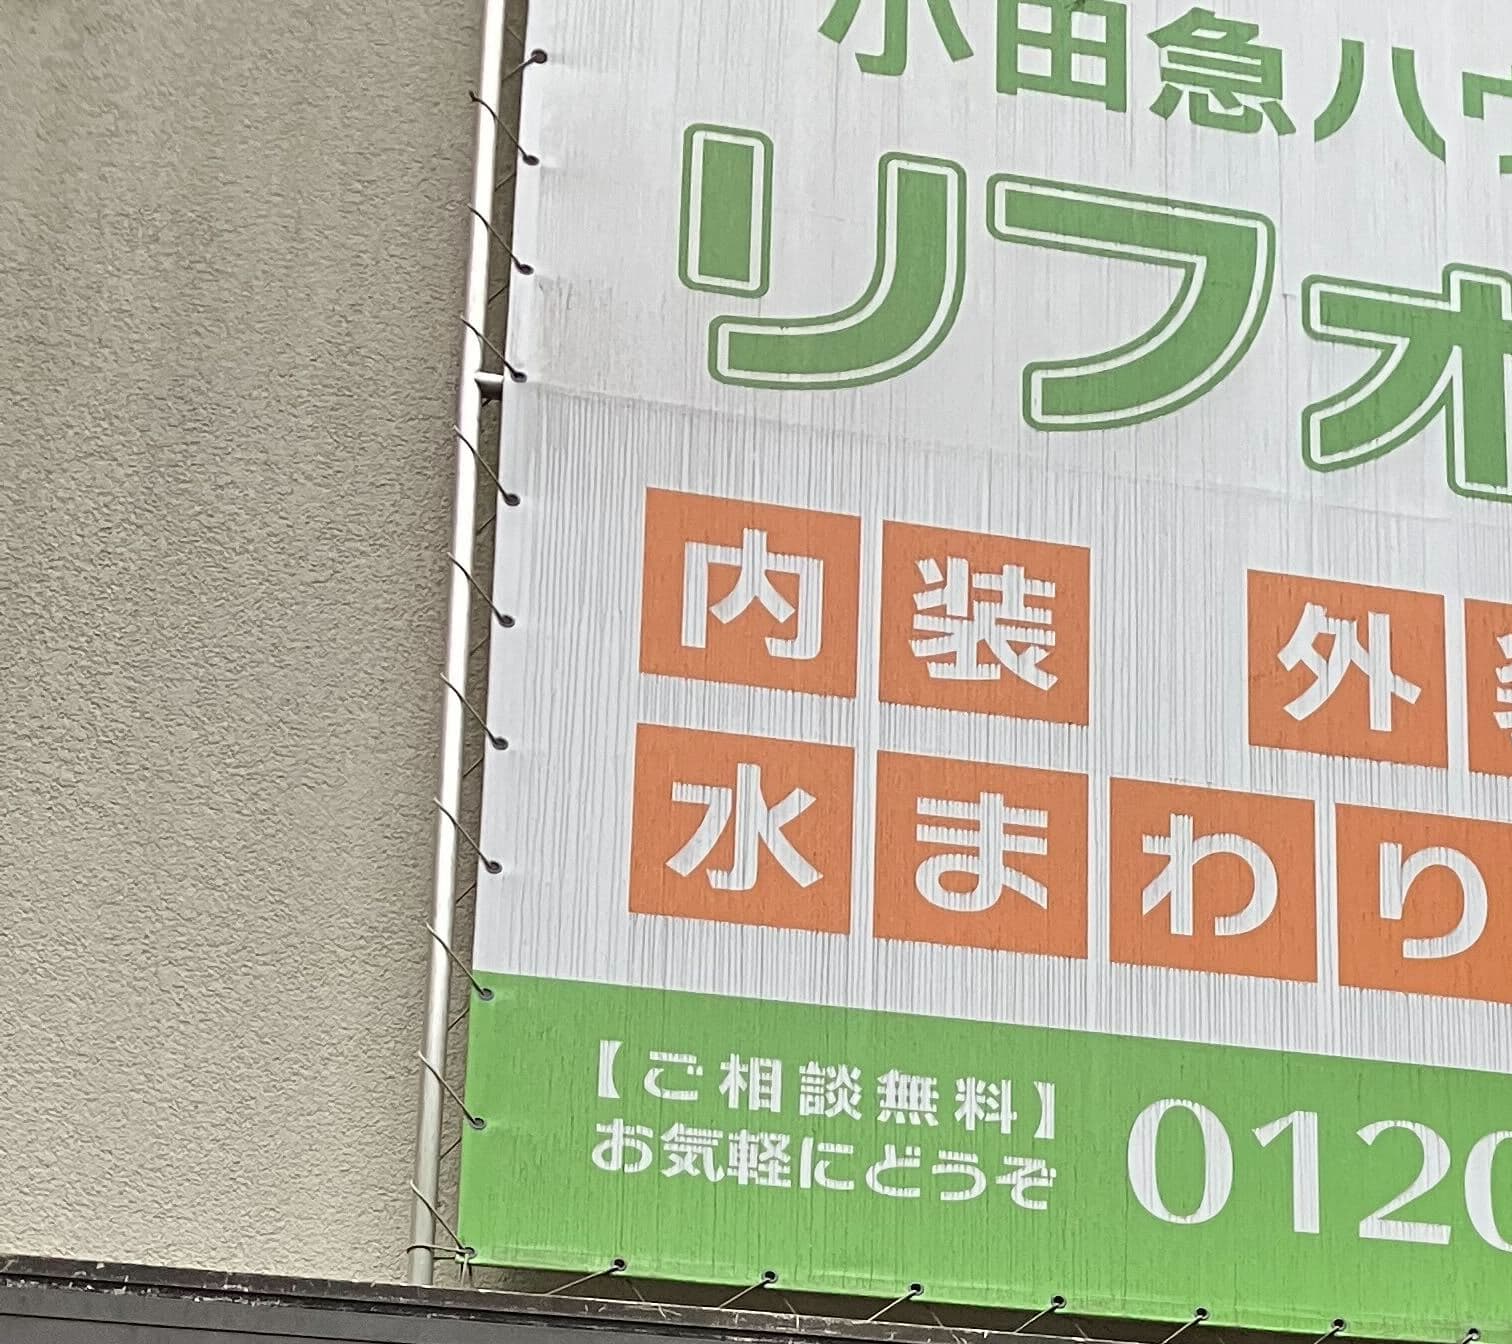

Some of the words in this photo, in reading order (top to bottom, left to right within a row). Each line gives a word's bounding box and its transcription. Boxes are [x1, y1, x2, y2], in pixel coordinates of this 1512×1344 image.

[679, 526, 1062, 694] 内装
[665, 760, 1489, 963] 水まわり
[591, 1117, 1056, 1210] お気軽にどうぞ
